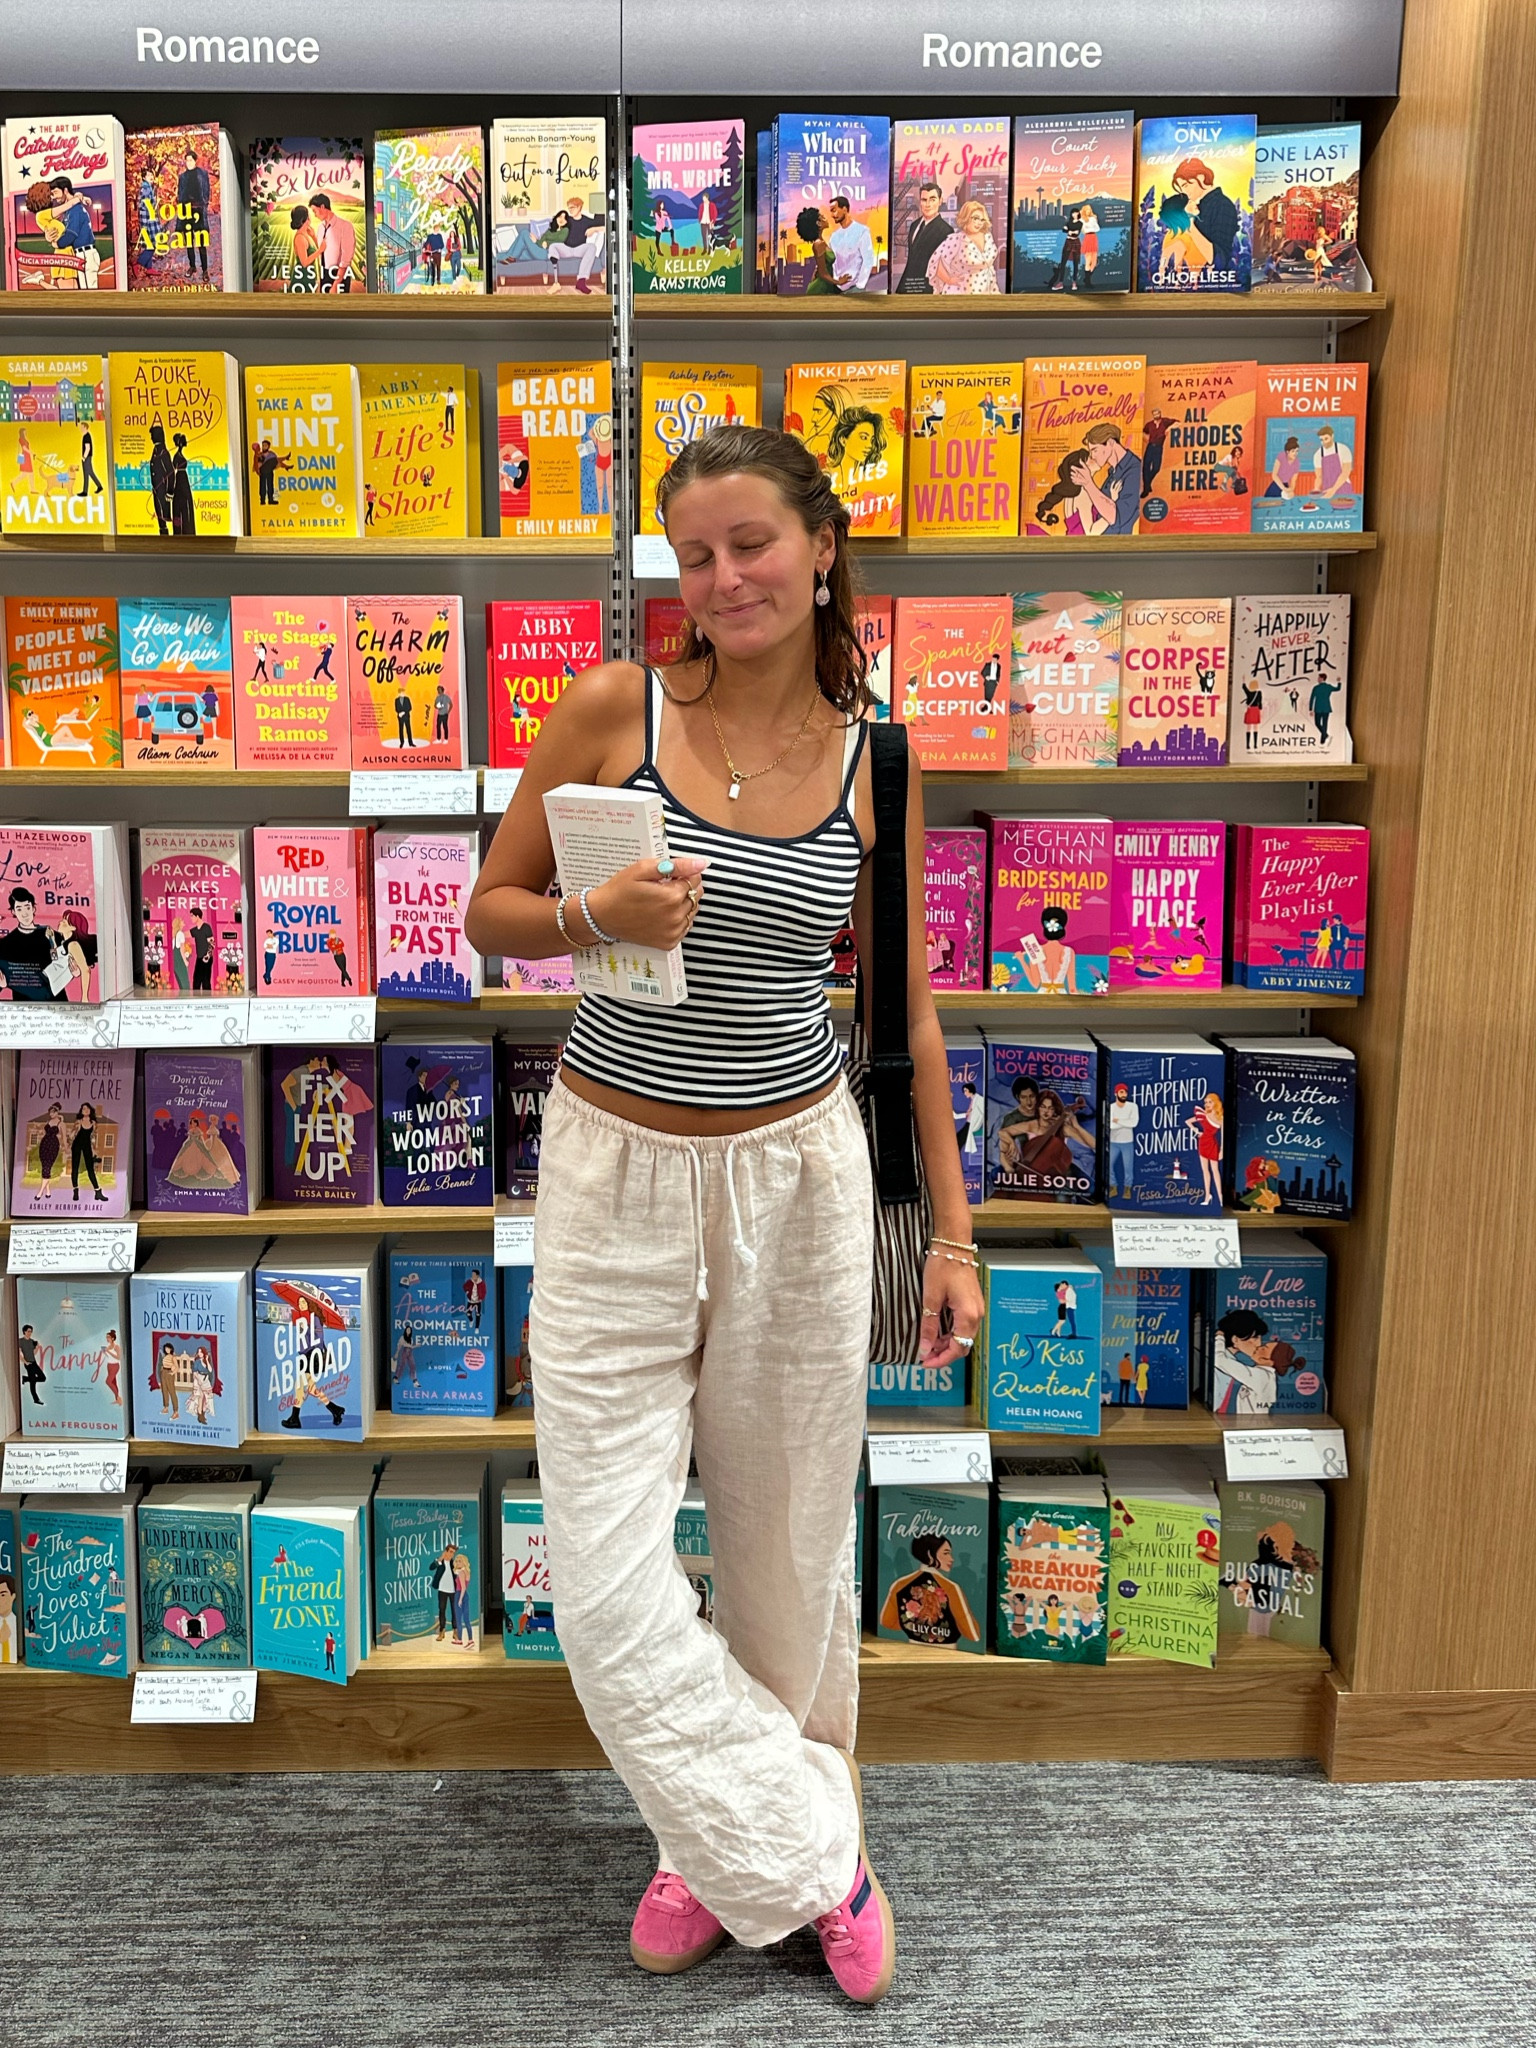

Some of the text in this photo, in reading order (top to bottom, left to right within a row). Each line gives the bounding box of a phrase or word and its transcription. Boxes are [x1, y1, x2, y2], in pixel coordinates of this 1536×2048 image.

[136, 27, 320, 64] Romance
[922, 33, 1102, 68] Romance
[14, 135, 79, 159] Catching
[504, 135, 596, 143] Hannah Bonam-Young
[1051, 136, 1099, 156] Count
[386, 140, 473, 183] Ready
[656, 141, 723, 163] FINDING
[1256, 144, 1349, 163] ONE LAST
[40, 152, 109, 178] Feelings
[805, 156, 862, 178] Think
[899, 144, 1008, 184] First Spite
[1284, 167, 1335, 184] SHOT
[276, 162, 354, 197] Ex Vows
[647, 168, 732, 190] MR. WRITE
[135, 227, 210, 257] Again
[18, 256, 80, 269] ALICIA THOMPSON
[270, 265, 356, 280] JESSICA
[1152, 270, 1236, 284] CHLOE LIESE
[669, 369, 734, 382] Ashley Poston
[1033, 361, 1142, 372] ALI HAZELWOOD
[124, 386, 213, 410] THE LADY,
[512, 377, 595, 406] BEACH
[1030, 393, 1139, 434] Theoretically
[1282, 397, 1341, 412] ROME
[257, 417, 344, 453] HINT,
[1170, 424, 1243, 448] RHODES
[930, 438, 997, 479] LOVE
[848, 460, 888, 483] LIES
[6, 495, 105, 524] MATCH
[375, 487, 454, 520] Short
[914, 483, 1010, 523] WAGER
[300, 519, 346, 527] HIBBERT
[516, 519, 598, 535] EMILY HENRY
[1254, 612, 1330, 638] HAPPILY
[15, 623, 107, 651] PEOPLE WE
[243, 630, 337, 648] Five Stages
[356, 629, 450, 652] CHARM
[498, 642, 598, 661] JIMENEZ
[904, 616, 1008, 688] Spanish
[1125, 647, 1226, 670] CORPSE
[362, 655, 444, 684] Offensive
[928, 671, 979, 688] LOVE
[21, 668, 104, 695] VACATION
[245, 680, 338, 701] Courting
[255, 703, 330, 724] Dalisay
[902, 700, 1006, 716] DECEPTION
[1034, 692, 1109, 715] CUTE
[1129, 695, 1220, 718] CLOSET
[138, 746, 219, 760] Alison Cochrun
[1261, 738, 1316, 746] PAINTER
[253, 753, 286, 761] MELISSA
[1003, 830, 1105, 847] MEGHAN
[1114, 835, 1219, 857] EMILY HENRY
[151, 863, 231, 877] PRACTICE
[1260, 854, 1325, 877] Happy
[260, 875, 349, 898] WHITE &
[998, 868, 1108, 890] BRIDESMAID
[1132, 869, 1200, 898] HAPPY
[44, 891, 90, 907] Brain
[157, 897, 228, 910] PERFECT
[388, 881, 461, 907] BLAST
[267, 902, 341, 928] ROYAL
[1260, 898, 1334, 923] Playlist
[274, 930, 330, 954] BLUE
[39, 1060, 113, 1076] DELILAH GREEN
[996, 1062, 1089, 1080] LOVE SONG
[1131, 1077, 1207, 1107] HAPPENED
[1255, 1080, 1340, 1105] Written
[293, 1112, 357, 1145] HER
[1135, 1129, 1199, 1156] SUMMER
[407, 1146, 484, 1176] LONDON
[403, 1173, 476, 1200] Julia Bennet
[994, 1172, 1090, 1190] JULIE SOTO
[294, 1189, 357, 1199] TESSA BAILEY
[156, 1291, 212, 1311] IRIS KELLY
[1226, 1296, 1317, 1310] Hypothesis
[274, 1312, 320, 1359] GIRL
[395, 1319, 467, 1331] ROOMMATE
[415, 1335, 490, 1347] EXPERIMENT
[1133, 1330, 1179, 1346] World
[35, 1344, 107, 1383] Nanny
[268, 1337, 351, 1400] ABROAD
[870, 1365, 953, 1391] LOVERS
[993, 1371, 1097, 1401] Quotient
[402, 1389, 483, 1401] ELENA ARMAS
[1256, 1401, 1317, 1409] HAZELWOOD
[1006, 1407, 1083, 1419] HELEN HOANG
[28, 1420, 118, 1431] LANA FERGUSON
[388, 1508, 450, 1531] Tessa Bailey
[882, 1511, 983, 1541] Takedown
[145, 1528, 238, 1550] UNDERTAKING
[1137, 1542, 1193, 1559] FAVORITE
[27, 1542, 116, 1591] Hundred
[1128, 1562, 1202, 1579] HALF-NIGHT
[257, 1569, 343, 1605] Friend
[384, 1574, 432, 1605] SINKER
[1007, 1575, 1101, 1594] VACATION
[1225, 1562, 1314, 1595] BUSINESS
[171, 1584, 215, 1603] MERCY
[1233, 1585, 1304, 1619] CASUAL
[270, 1605, 340, 1630] ZONE
[1114, 1611, 1214, 1639] CHRISTINA
[39, 1612, 110, 1653] Juliet
[912, 1624, 951, 1637] LILY CHU
[194, 1653, 241, 1661] BANNEN
[515, 1643, 556, 1652] TIMOTHY
